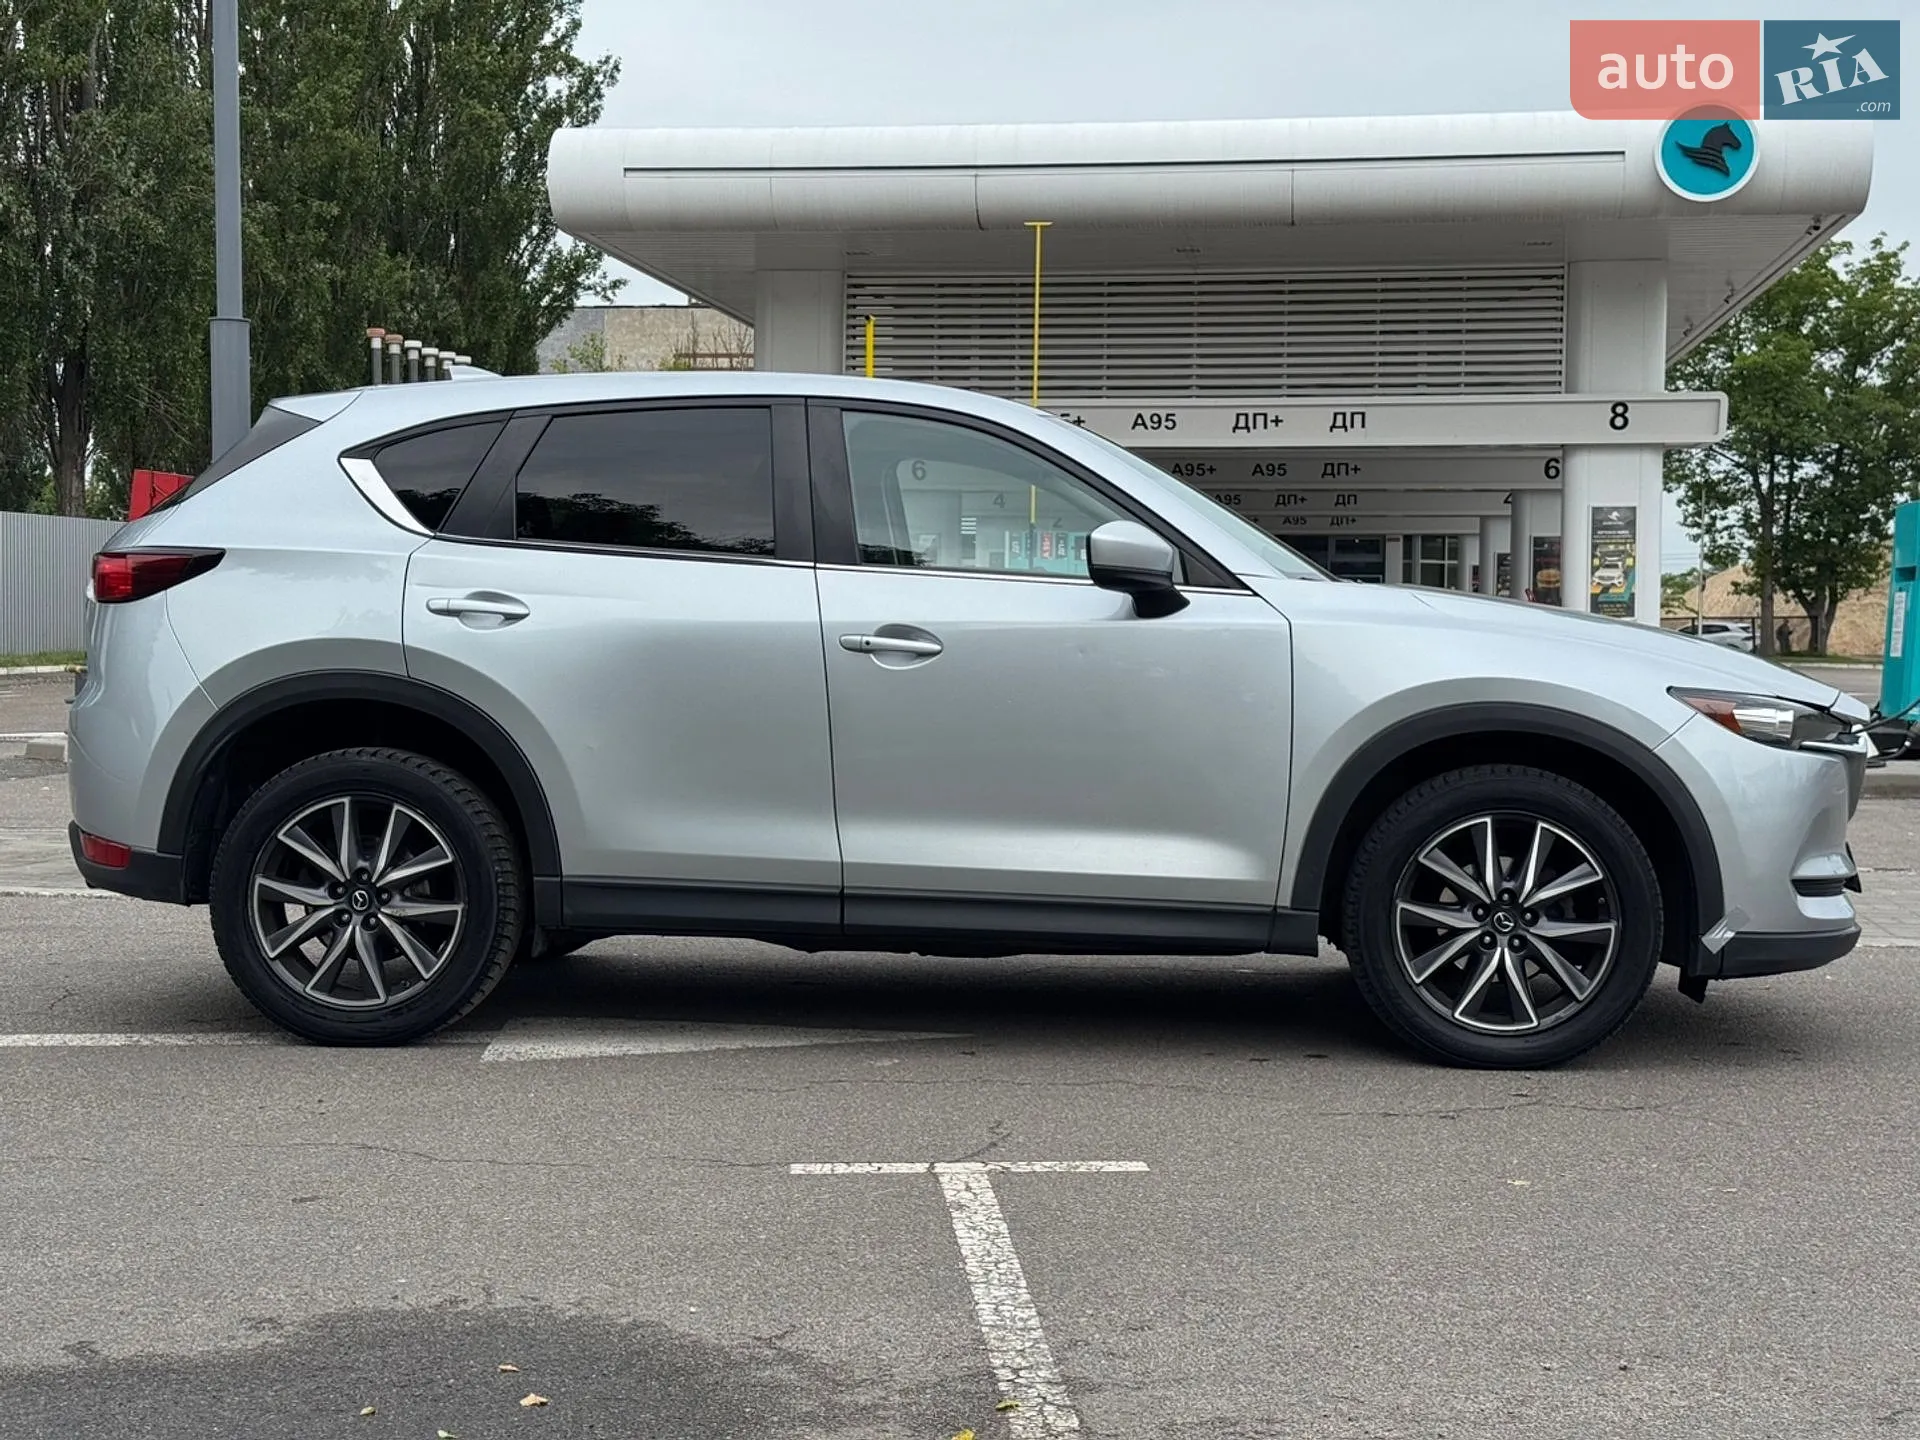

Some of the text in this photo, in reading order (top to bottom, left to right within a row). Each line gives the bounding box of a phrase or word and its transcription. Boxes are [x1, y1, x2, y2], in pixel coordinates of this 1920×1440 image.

[1131, 412, 1177, 431] А95
[1231, 412, 1284, 434] ДП+
[1329, 411, 1367, 433] ДП
[1609, 401, 1630, 431] 8
[911, 460, 927, 481] 6
[1321, 462, 1361, 479] ДП+
[1543, 457, 1561, 480] 6
[1275, 494, 1308, 508] ДП+
[1334, 494, 1358, 507] ДП
